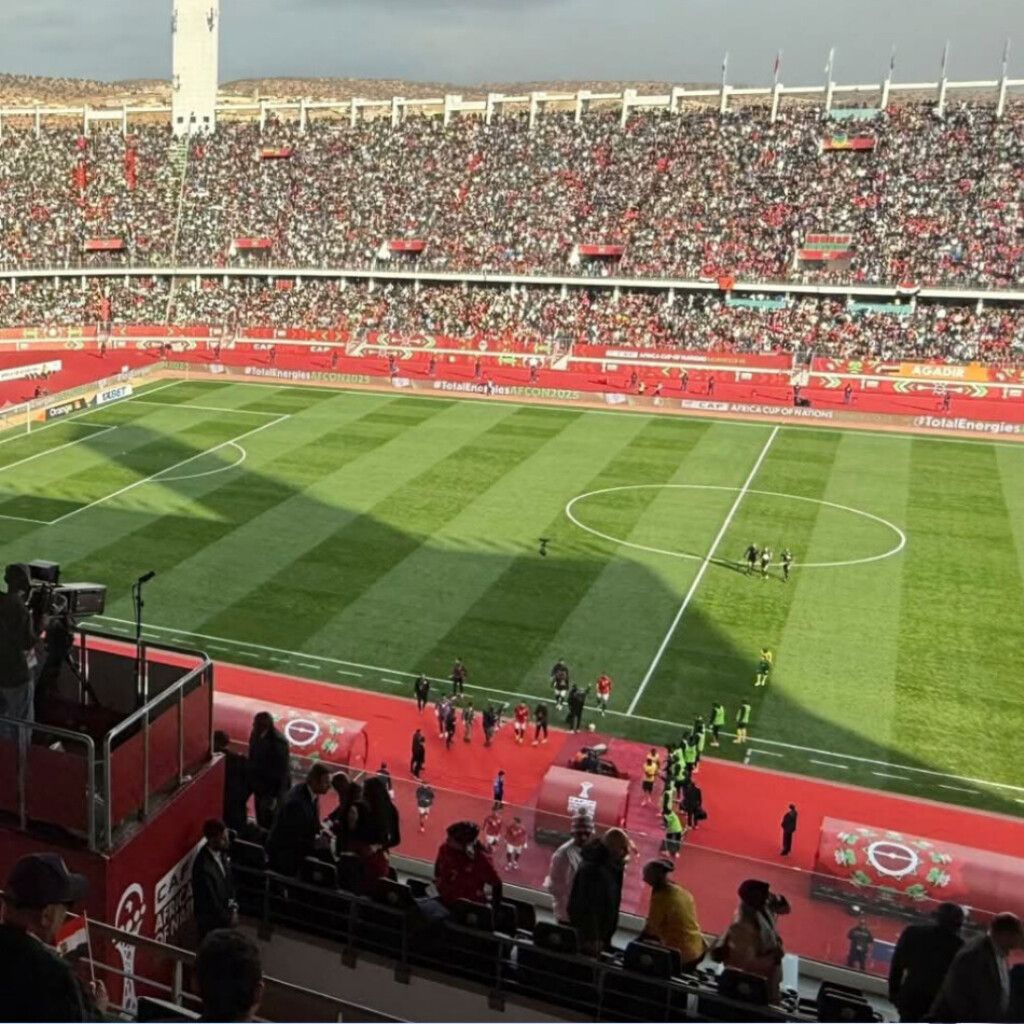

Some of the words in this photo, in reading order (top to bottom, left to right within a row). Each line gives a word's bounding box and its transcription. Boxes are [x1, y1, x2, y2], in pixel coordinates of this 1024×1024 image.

[912, 367, 965, 377] AGADIR
[49, 404, 73, 417] Orange
[731, 404, 761, 413] AFRICA
[762, 406, 780, 414] CUP
